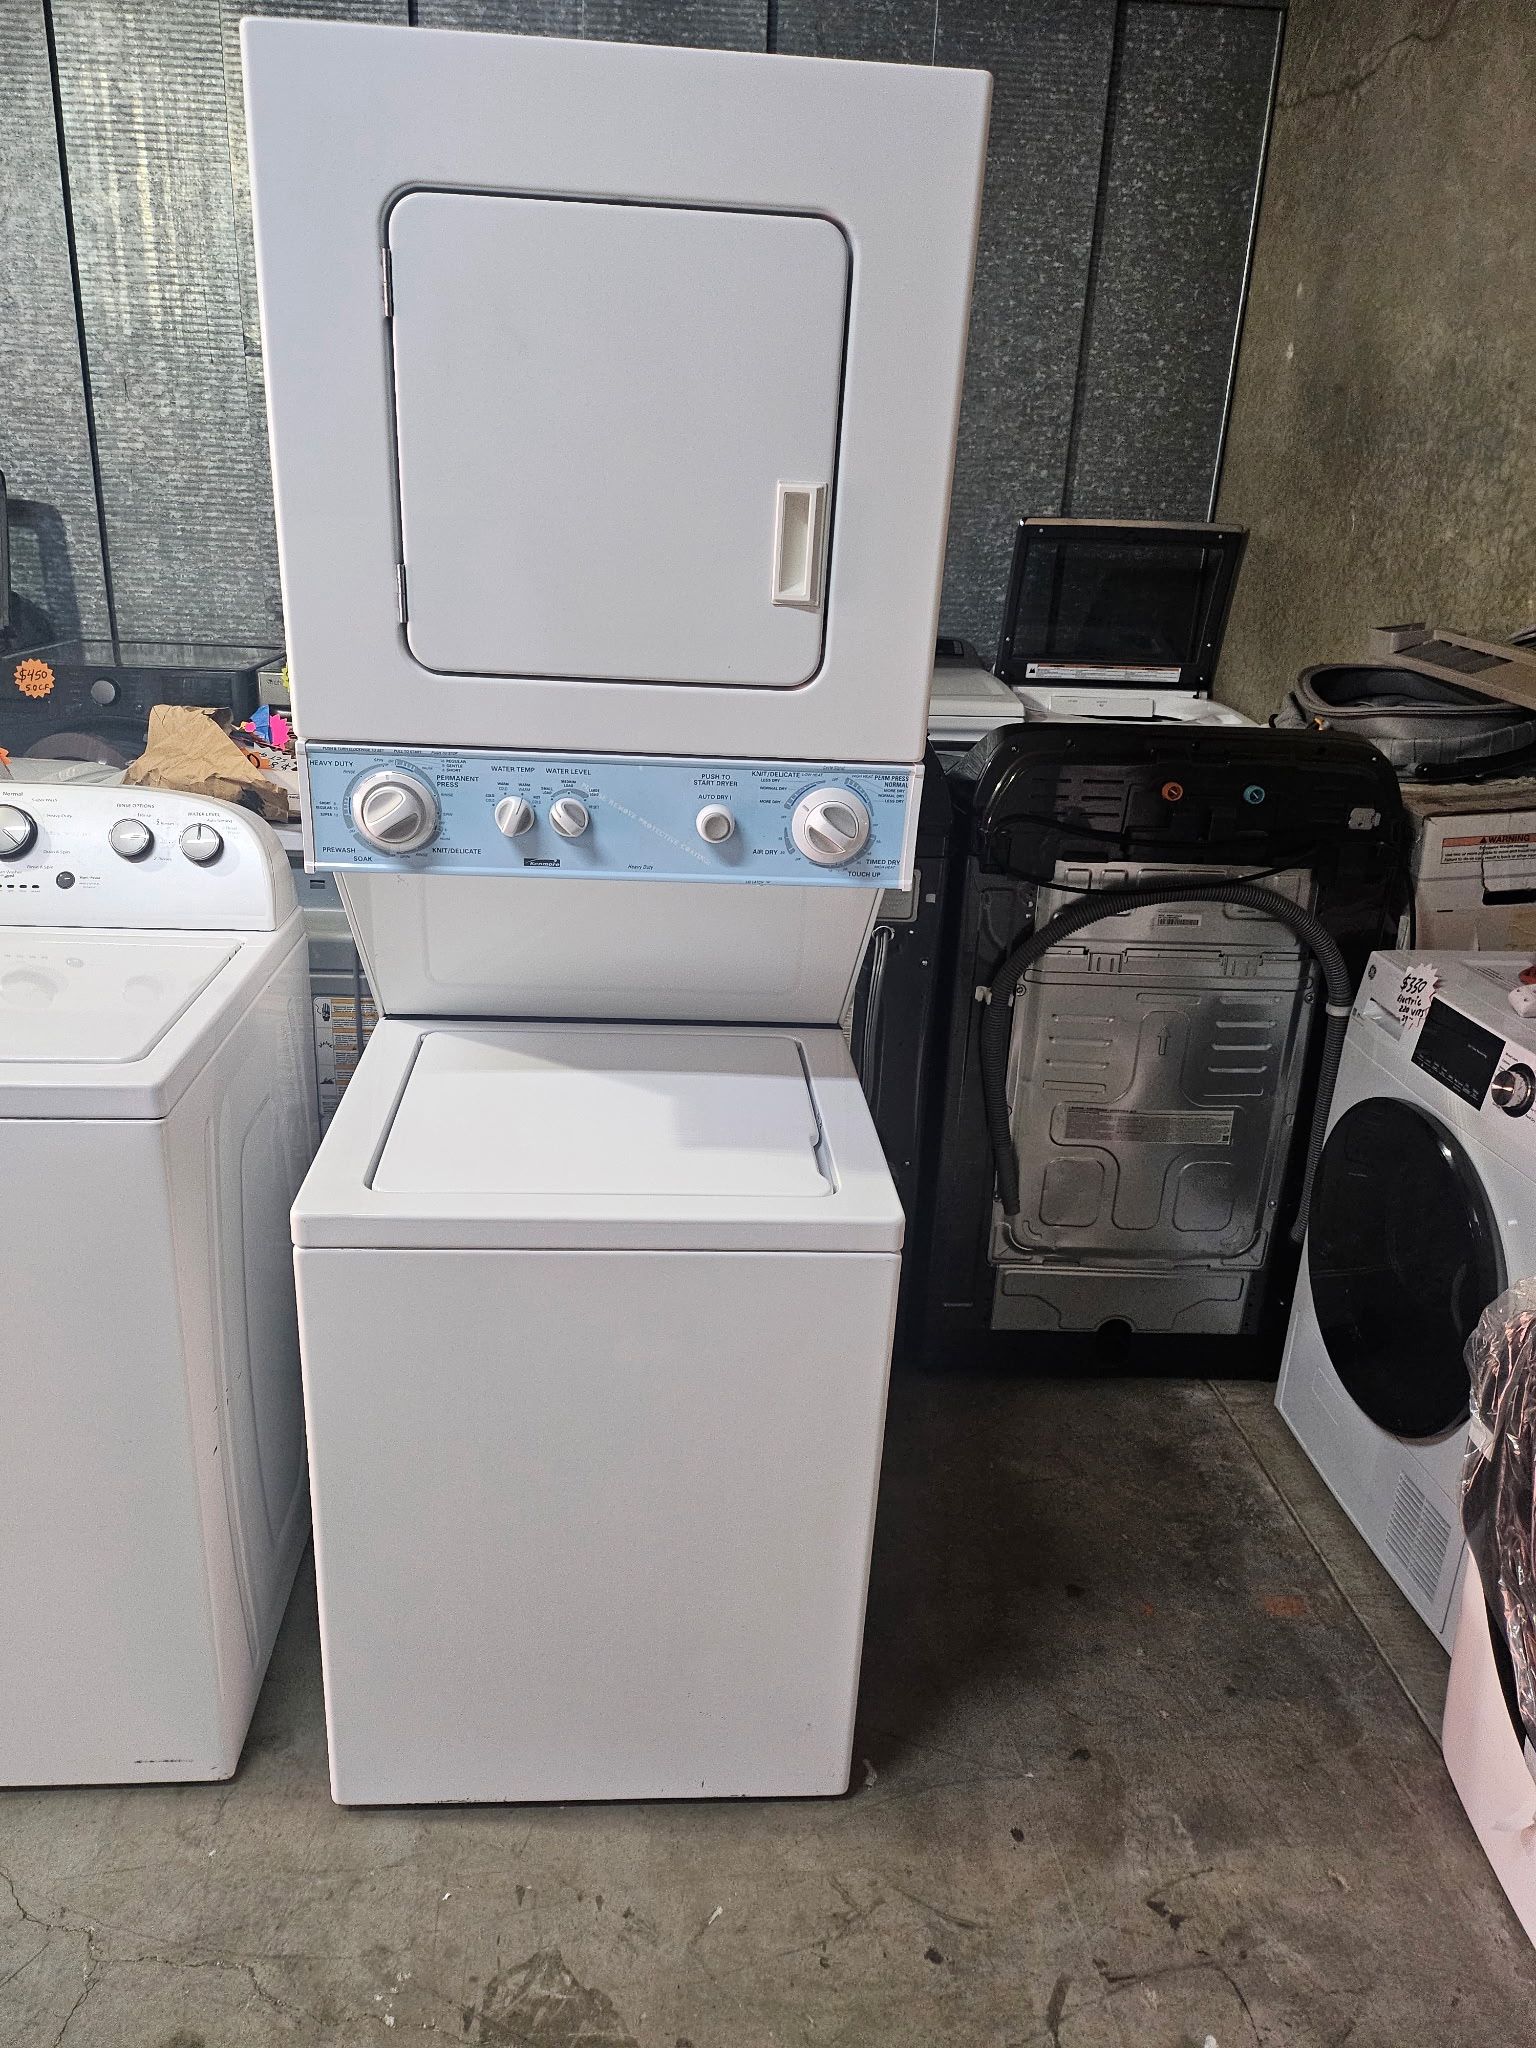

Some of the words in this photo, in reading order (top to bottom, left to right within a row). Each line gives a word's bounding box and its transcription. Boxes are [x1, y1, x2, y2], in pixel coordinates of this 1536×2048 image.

[19, 667, 48, 683] $450
[1488, 834, 1530, 843] WARNING
[432, 847, 482, 855] KNIT/DELICATE
[530, 860, 560, 868] Kenmore
